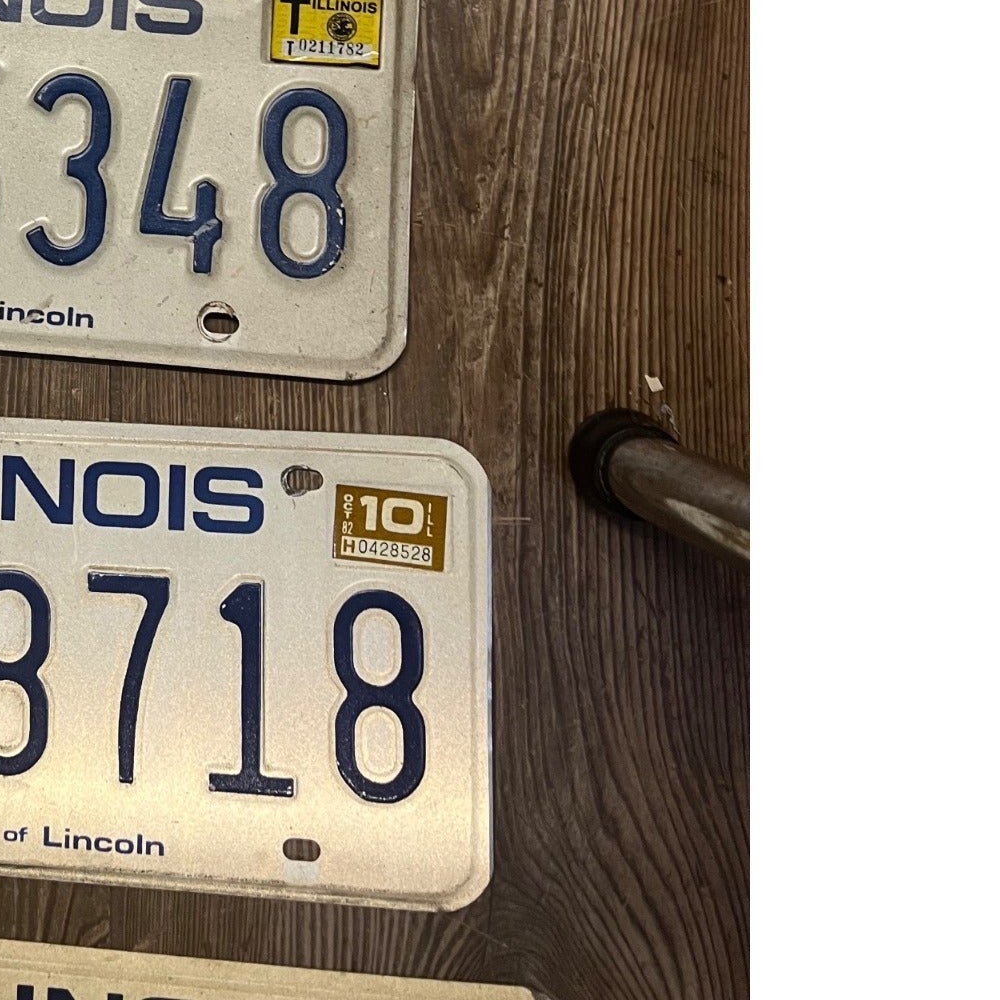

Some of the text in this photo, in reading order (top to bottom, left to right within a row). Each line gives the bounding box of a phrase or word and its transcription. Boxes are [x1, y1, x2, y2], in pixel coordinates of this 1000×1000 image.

[342, 494, 354, 535] OCT 82
[360, 495, 424, 535] 10
[3, 827, 28, 842] of
[43, 826, 165, 856] Lincoln
